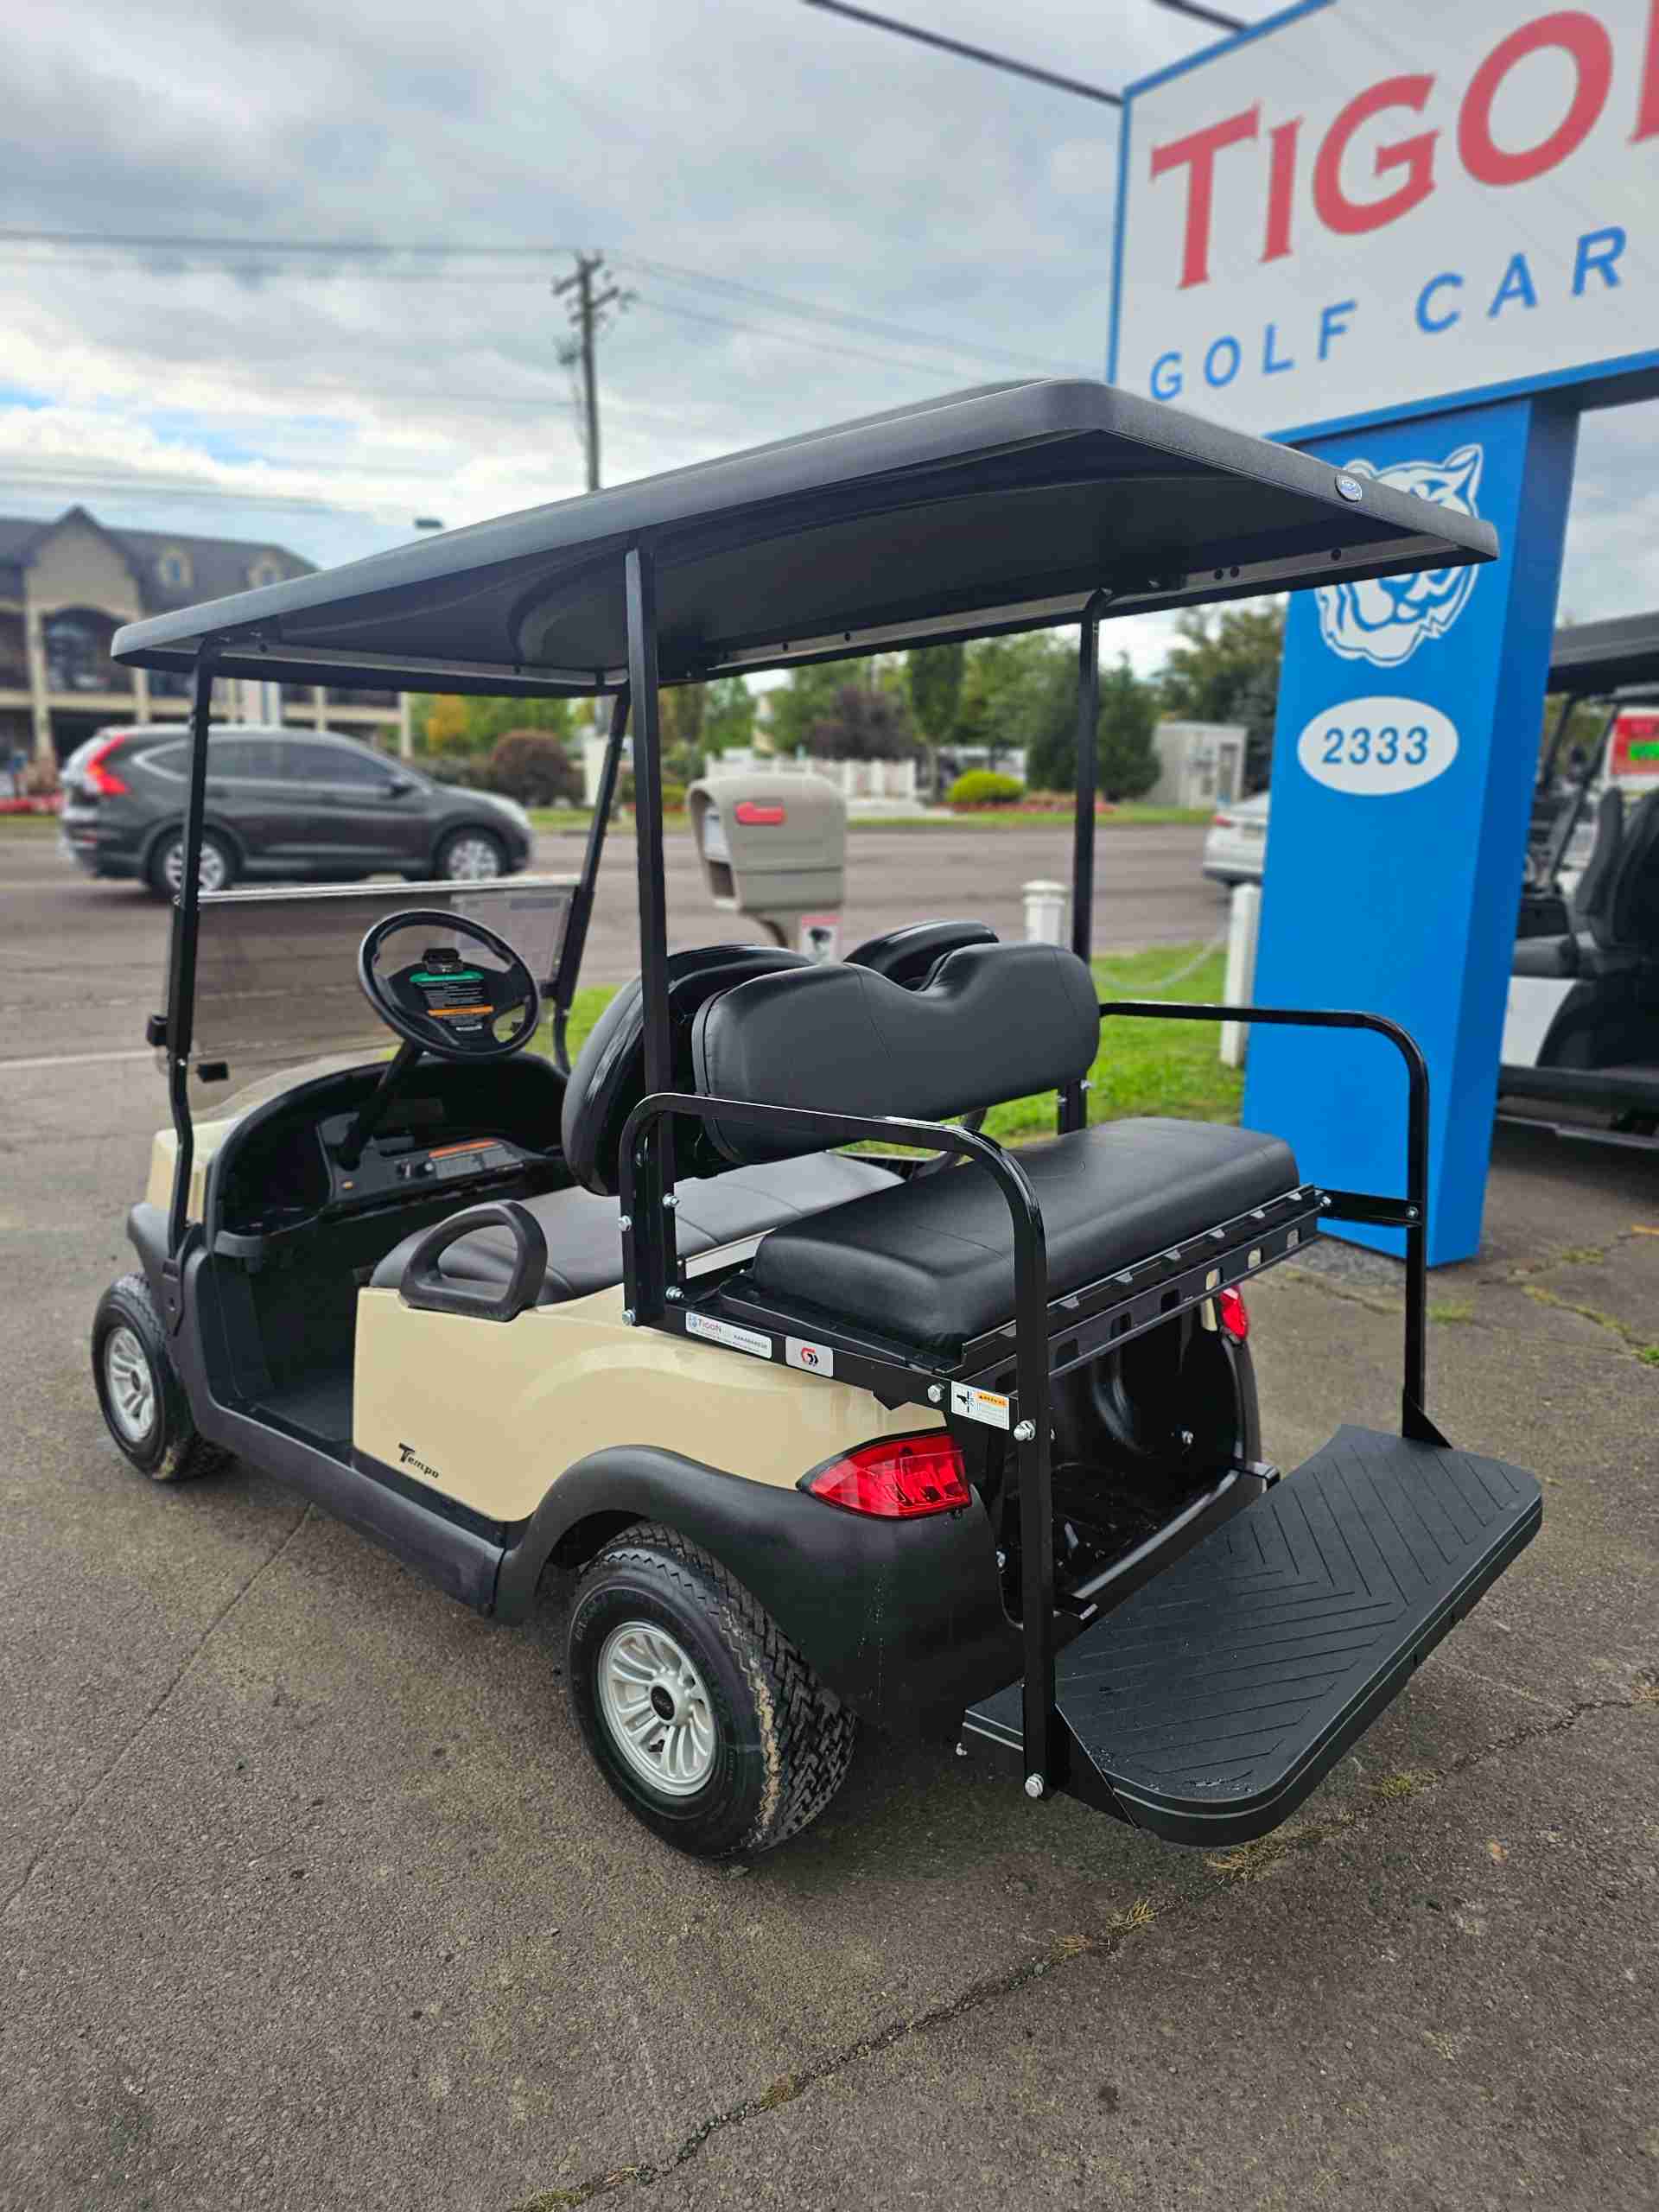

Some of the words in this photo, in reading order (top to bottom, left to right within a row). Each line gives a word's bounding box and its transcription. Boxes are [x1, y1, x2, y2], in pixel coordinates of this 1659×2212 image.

[1149, 0, 1659, 290] TIGO
[1149, 300, 1357, 401] GOLF
[1414, 226, 1627, 334] CAR
[1322, 726, 1429, 766] 2333
[398, 1442, 440, 1478] Tempo
